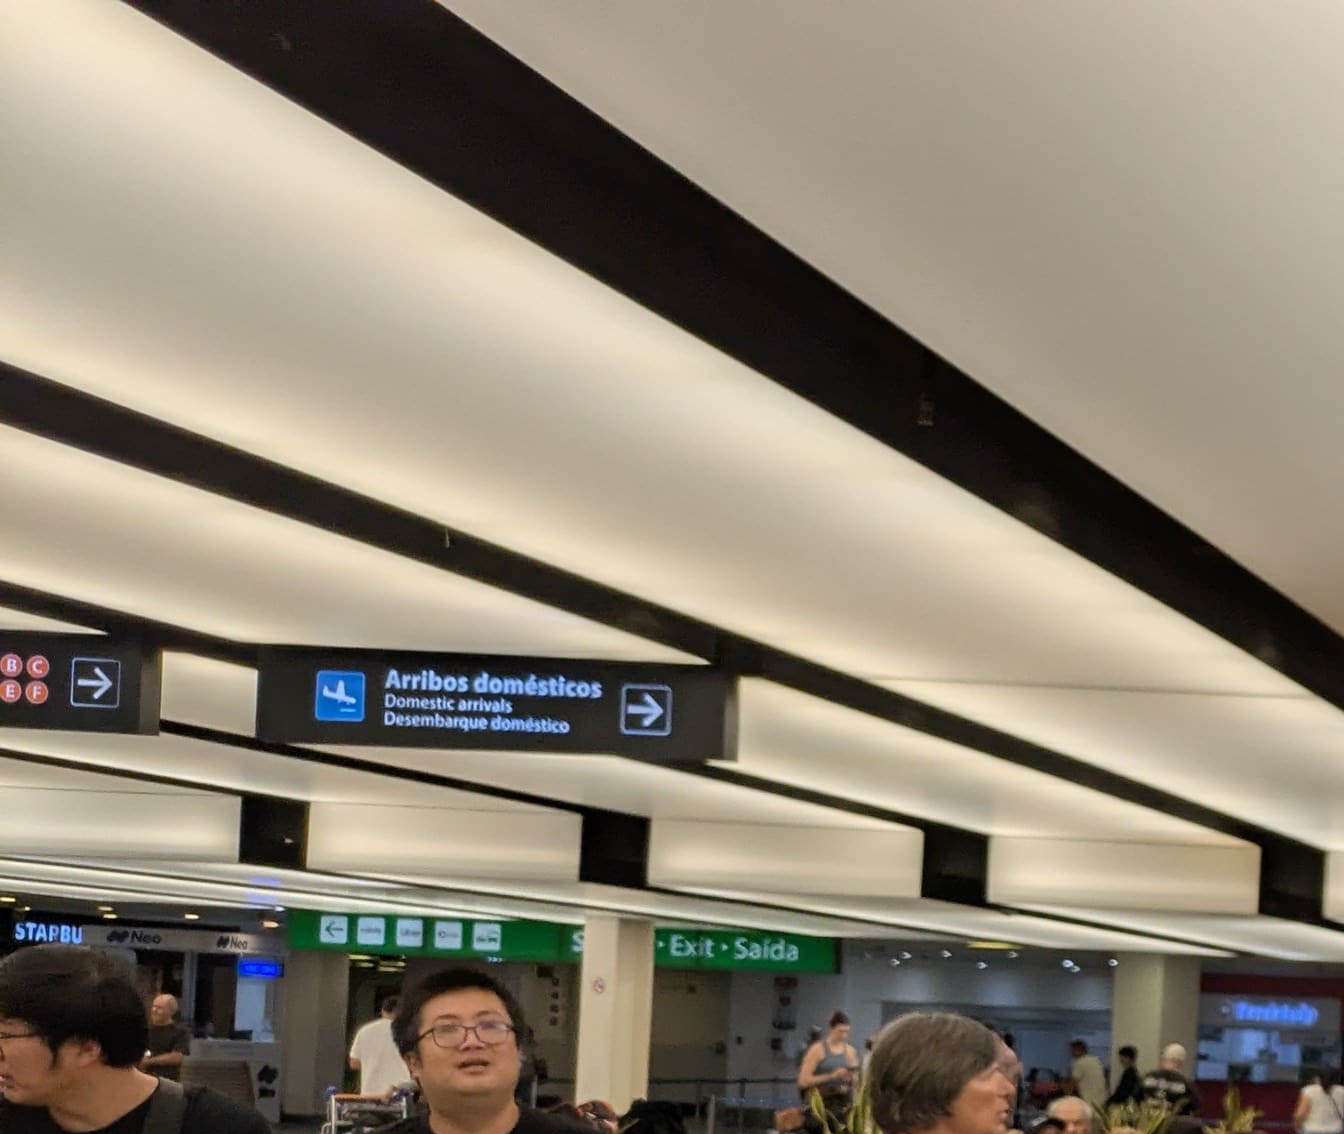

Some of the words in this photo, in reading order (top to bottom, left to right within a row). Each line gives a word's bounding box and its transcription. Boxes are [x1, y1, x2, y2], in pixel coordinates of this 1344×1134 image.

[6, 659, 17, 673] B
[31, 660, 43, 674] C
[5, 683, 15, 698] E
[32, 686, 42, 700] F
[385, 669, 468, 693] Arribos
[474, 672, 603, 699] domésticos
[384, 693, 455, 710] Domestic
[458, 698, 513, 713] arrivals
[384, 711, 488, 732] Desembarque
[491, 714, 570, 734] doméstico
[15, 921, 83, 945] STARBU
[130, 932, 162, 945] Neo
[230, 936, 248, 950] Neo
[669, 933, 715, 957] Exit
[734, 937, 799, 962] Saída
